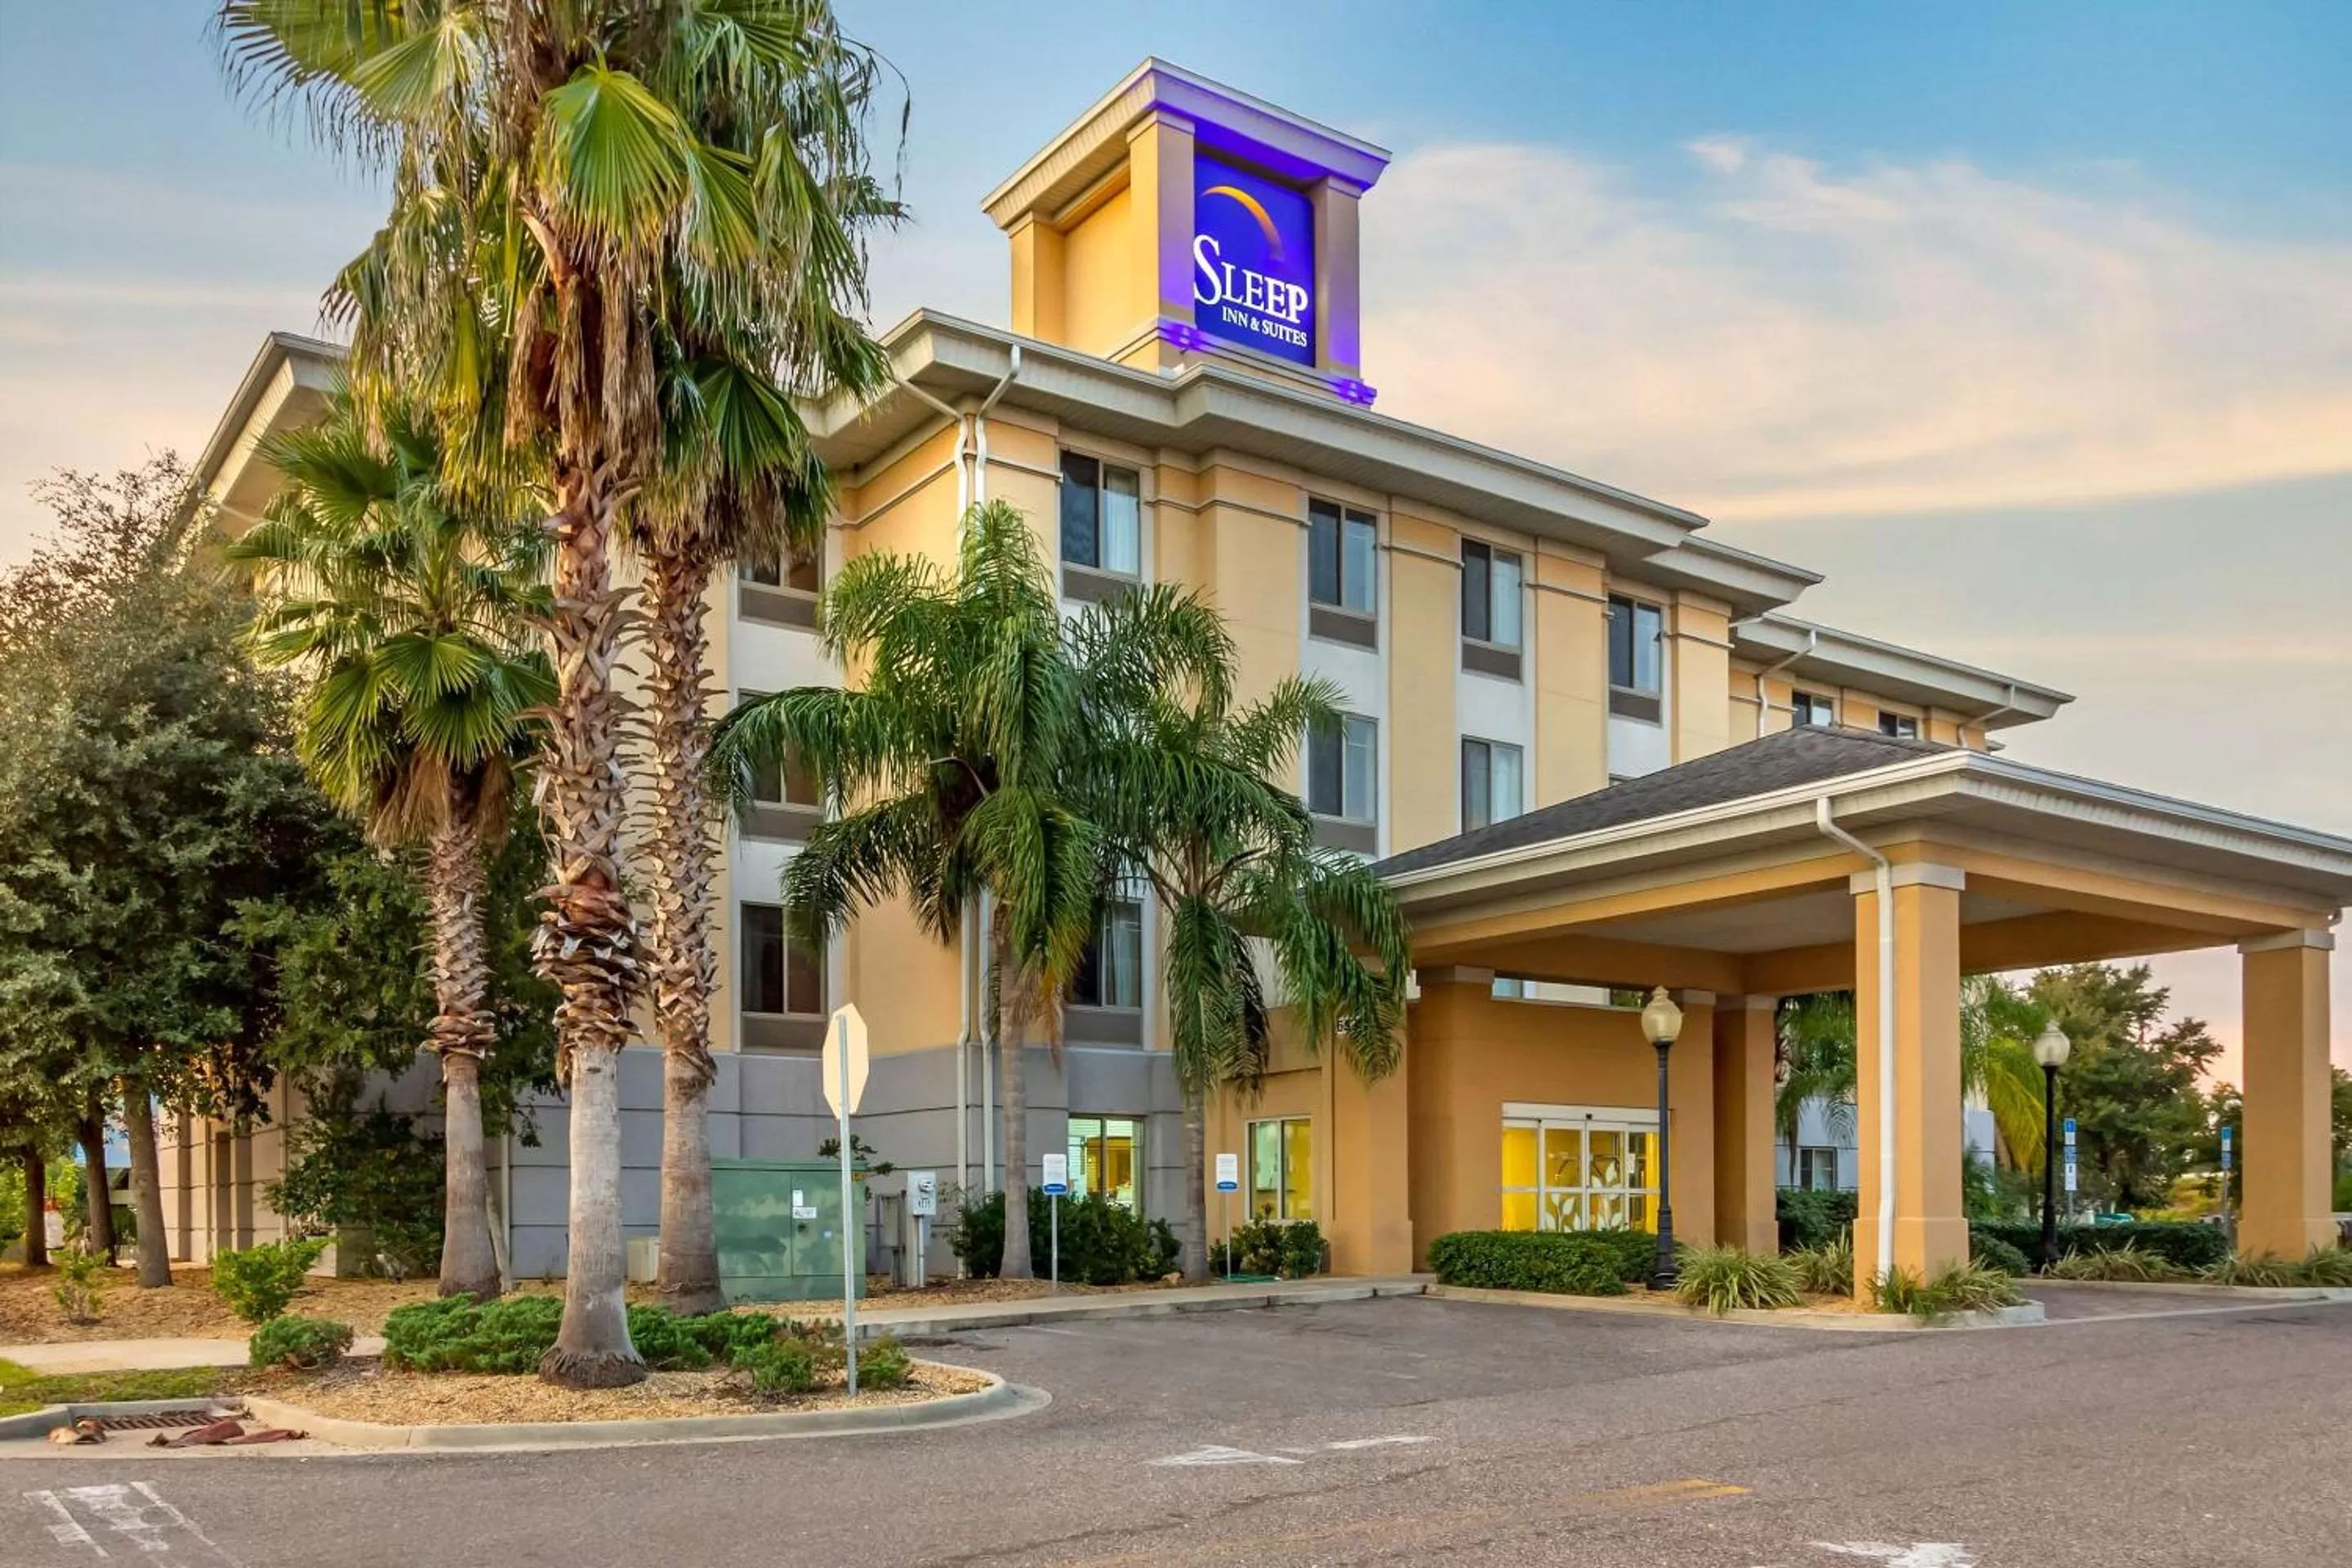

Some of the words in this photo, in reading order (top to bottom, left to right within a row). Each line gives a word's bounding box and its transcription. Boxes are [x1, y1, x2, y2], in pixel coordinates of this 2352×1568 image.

[1192, 234, 1308, 323] SLEEP
[1222, 306, 1248, 328] INN
[1250, 317, 1259, 332] &
[1262, 319, 1307, 347] SUITES
